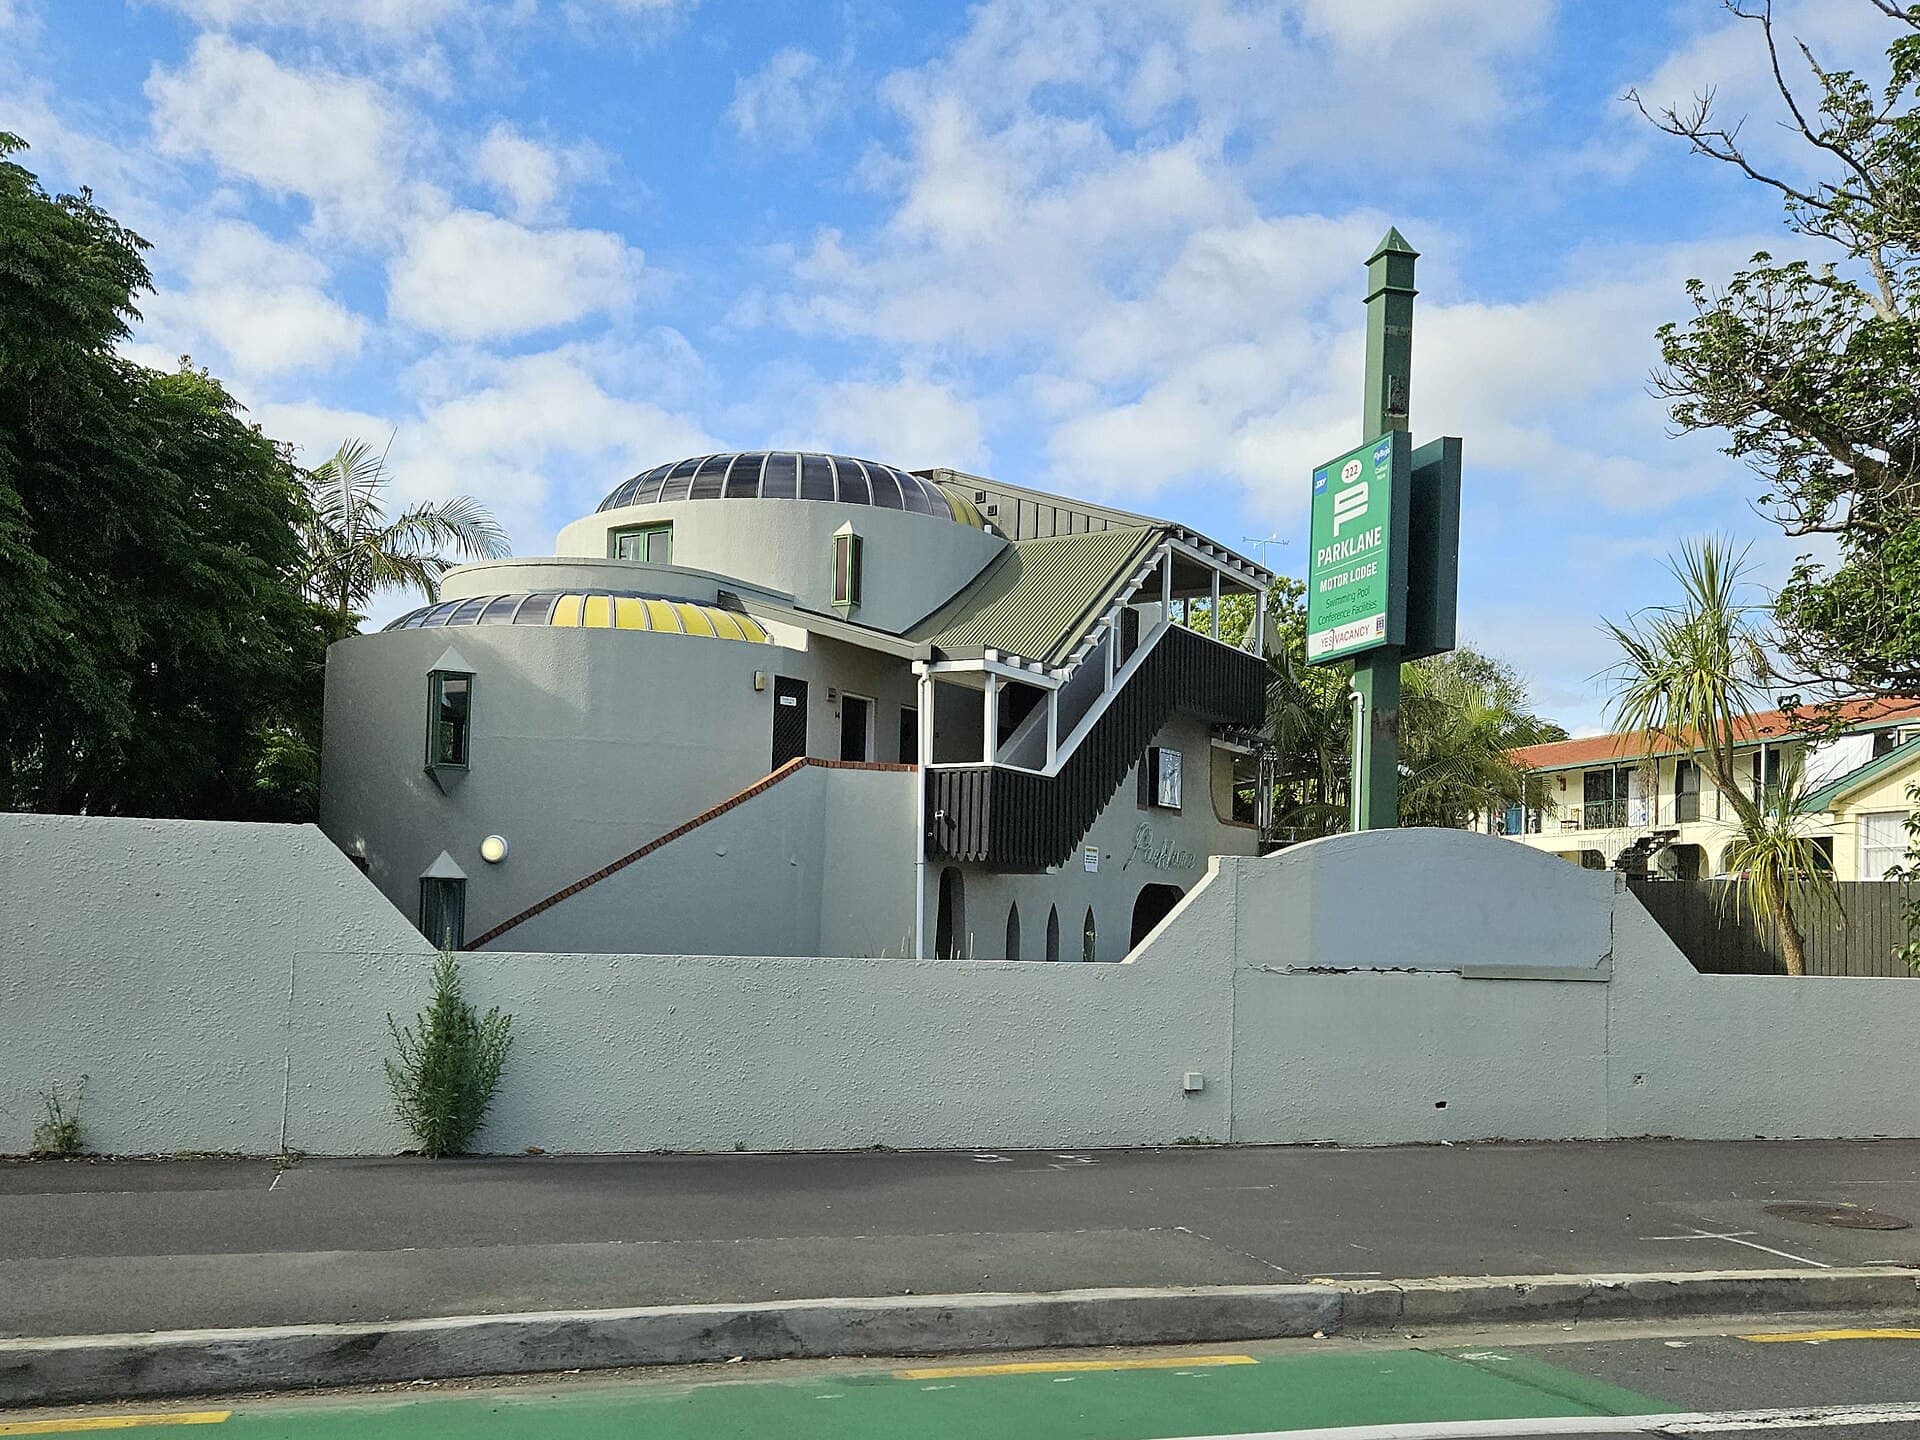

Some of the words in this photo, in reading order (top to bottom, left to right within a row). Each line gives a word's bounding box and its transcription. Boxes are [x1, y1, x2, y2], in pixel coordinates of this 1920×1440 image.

[1345, 464, 1359, 479] 222
[1317, 526, 1383, 568] PARKLANE
[1319, 571, 1349, 593] MOTOR
[1350, 561, 1378, 585] LODGE
[1325, 589, 1356, 609] Swimming
[1357, 584, 1371, 601] Pool
[1317, 606, 1351, 626] Conference
[1352, 599, 1378, 618] Facilities
[1320, 636, 1333, 649] YES
[1334, 624, 1370, 645] VACANCY
